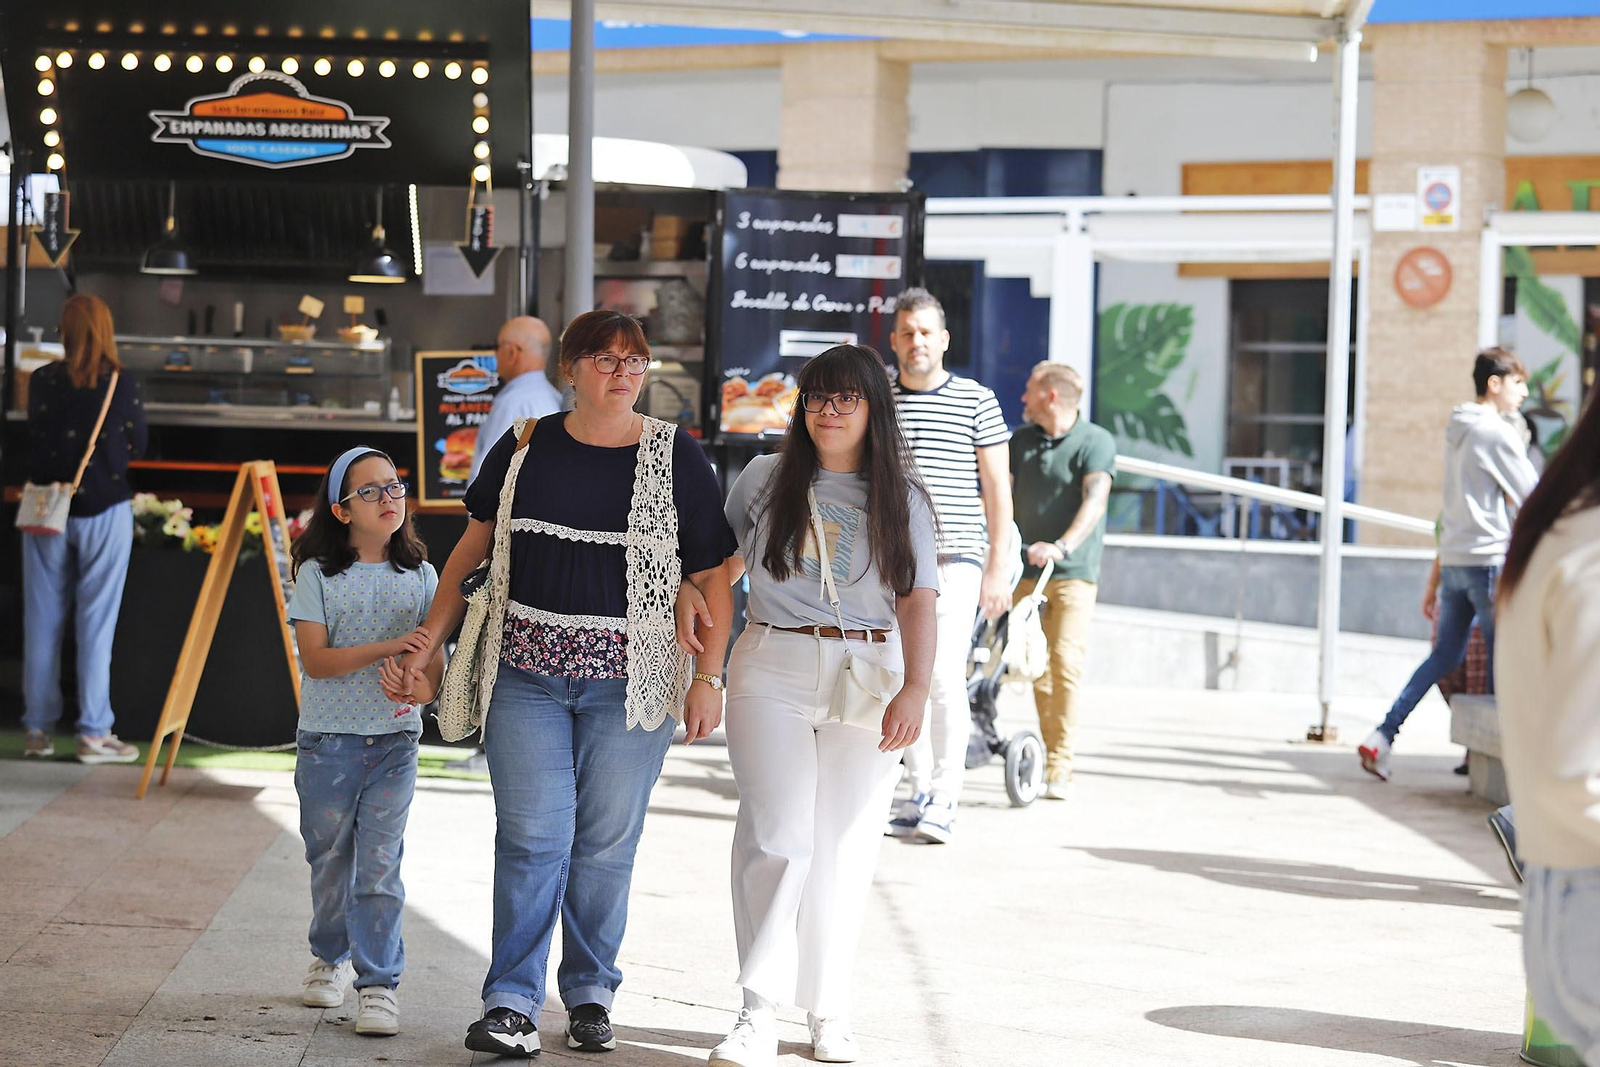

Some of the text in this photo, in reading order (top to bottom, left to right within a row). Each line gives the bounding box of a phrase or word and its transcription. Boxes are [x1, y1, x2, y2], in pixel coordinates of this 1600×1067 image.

[170, 119, 372, 140] EMPANADAS ARGENTINAS
[736, 211, 751, 230] 3
[735, 251, 749, 270] 6
